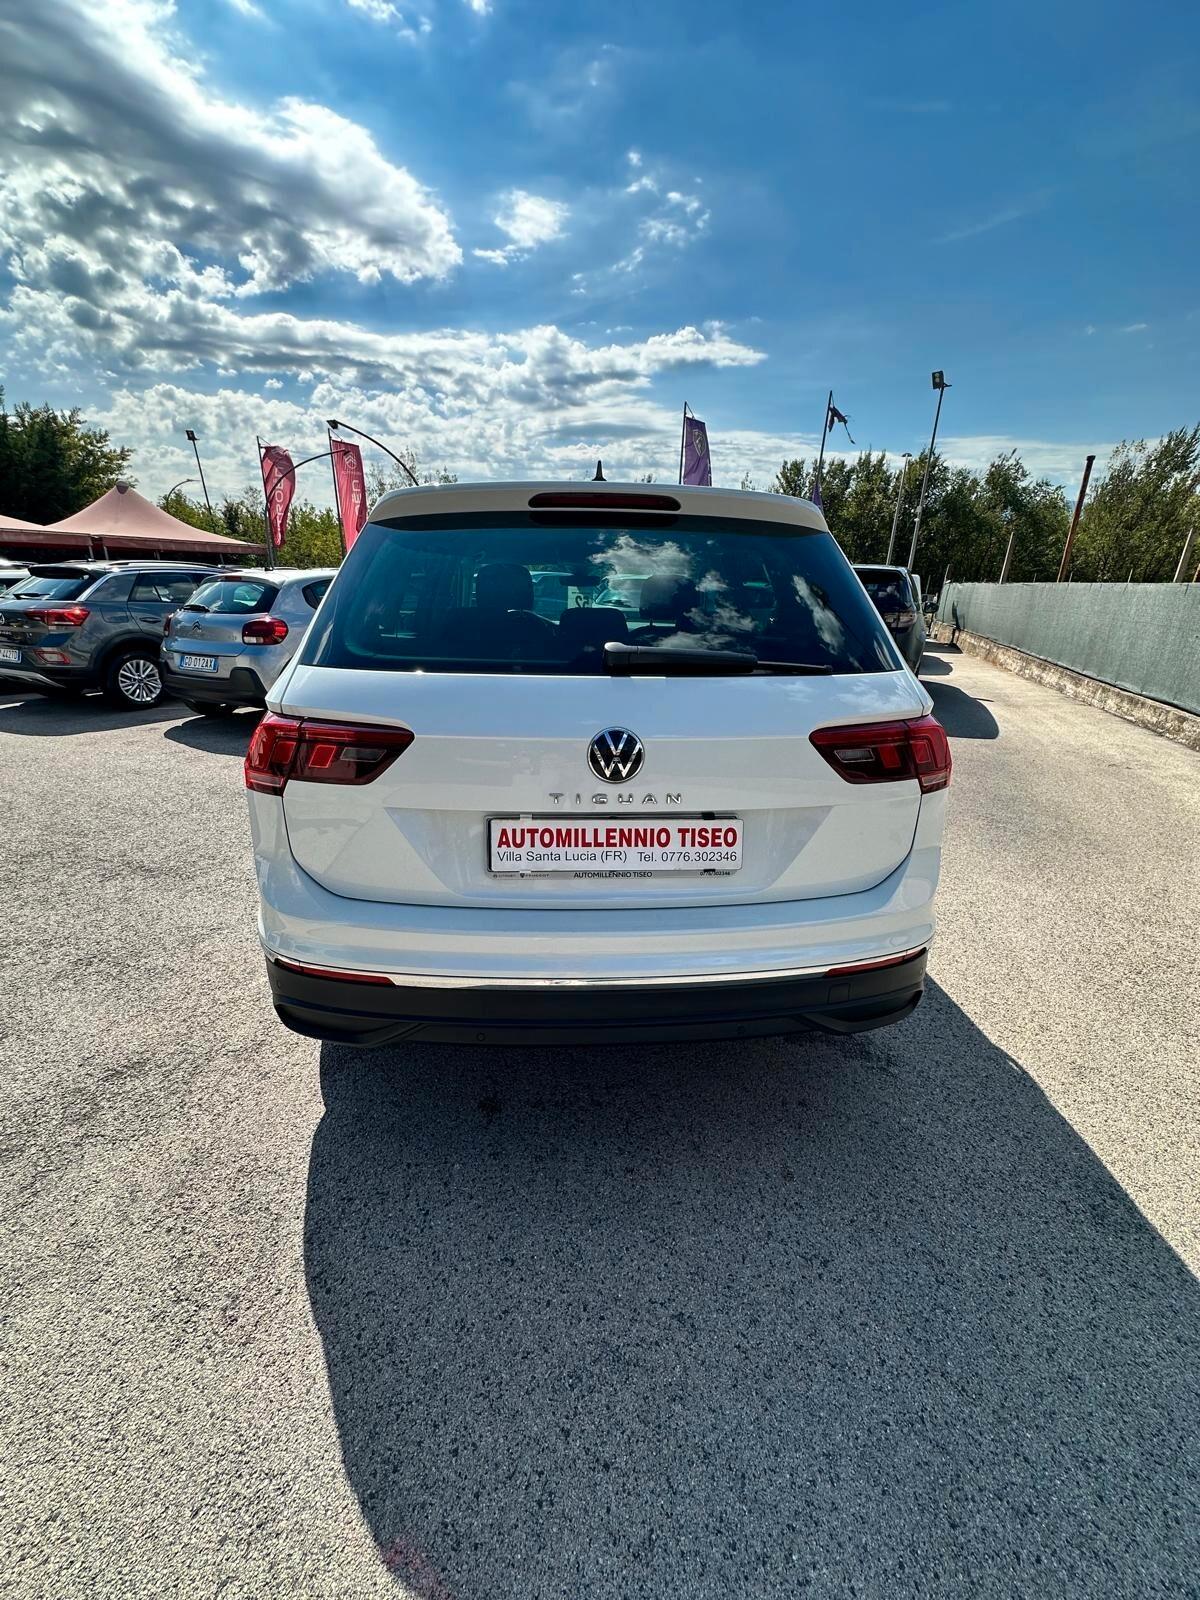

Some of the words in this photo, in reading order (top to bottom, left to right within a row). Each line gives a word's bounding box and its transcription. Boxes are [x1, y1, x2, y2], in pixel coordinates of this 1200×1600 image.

[549, 793, 682, 805] TIGUAN
[497, 827, 671, 849] AUTOMILLENNIO
[677, 827, 738, 848] TISEO
[497, 851, 522, 862] Villa
[526, 851, 561, 862] Santa
[565, 850, 597, 861] Lucia
[600, 850, 628, 863] (FR)
[637, 851, 658, 862] Tel.
[661, 851, 738, 862] 0776.302346
